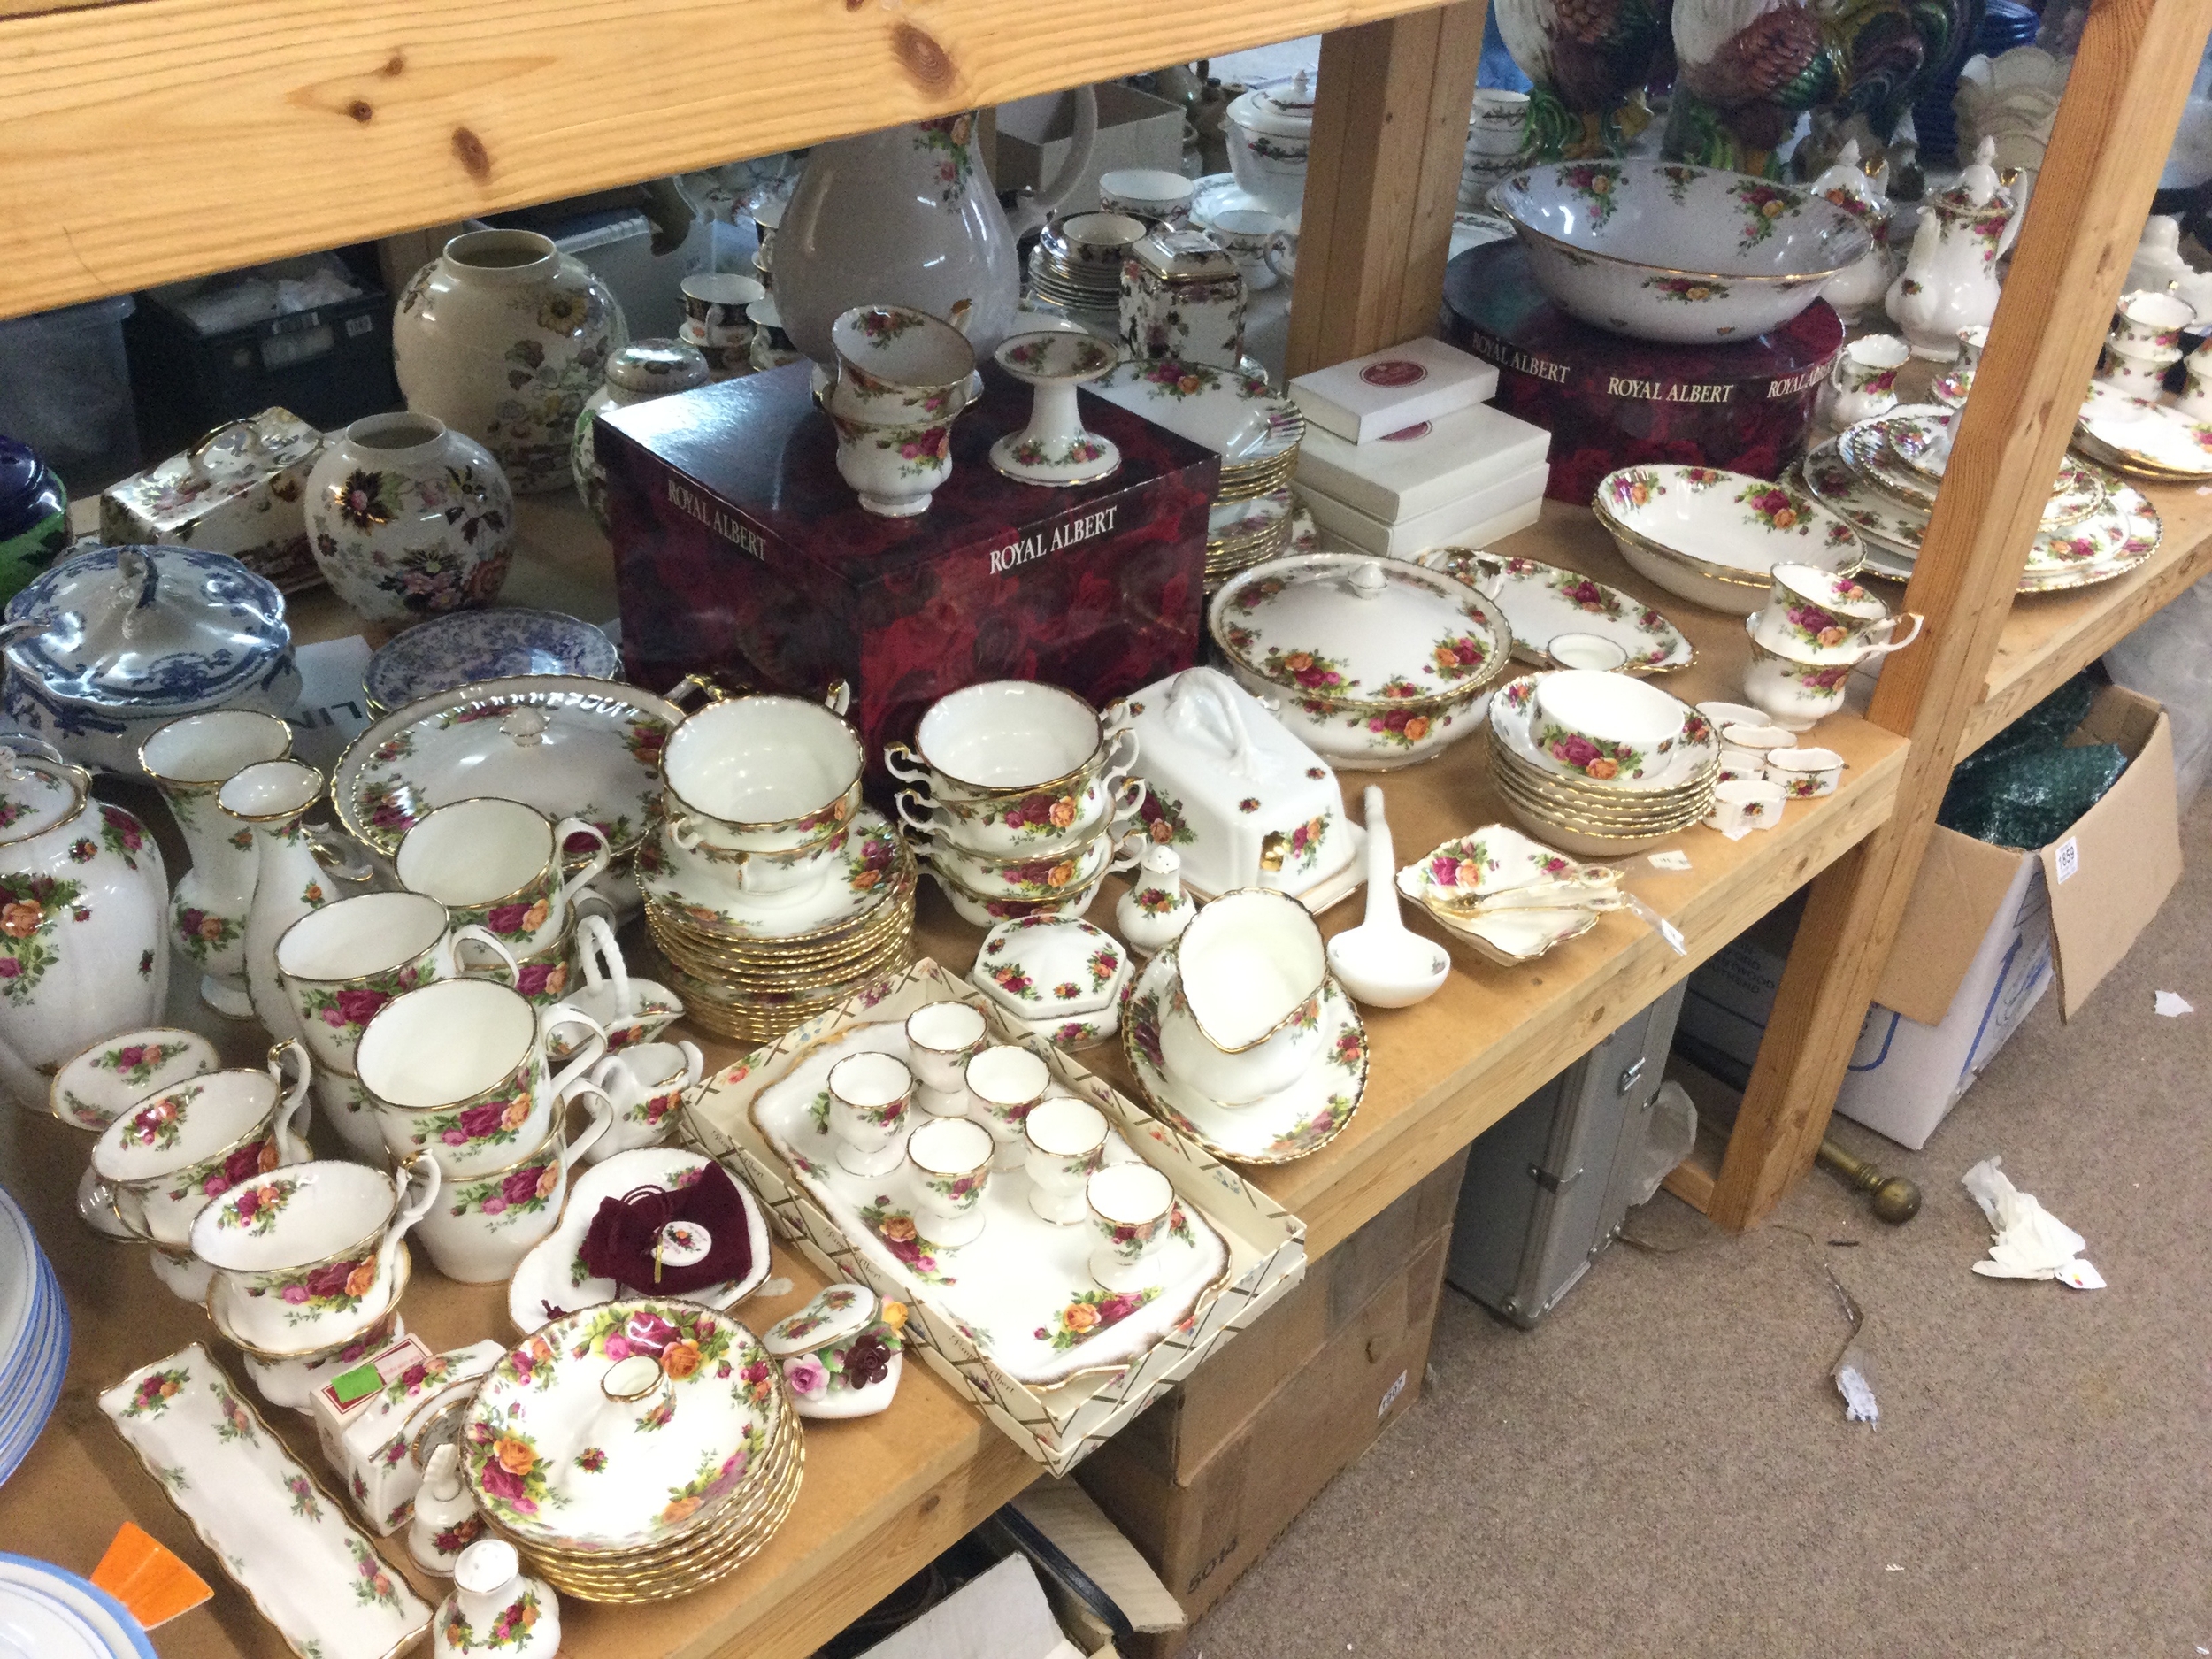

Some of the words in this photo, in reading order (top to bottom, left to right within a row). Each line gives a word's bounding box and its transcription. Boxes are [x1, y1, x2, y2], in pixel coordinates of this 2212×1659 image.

[1472, 331, 1508, 365] ROYAL
[1510, 352, 1571, 384] ALBERT
[1608, 377, 1663, 400] ROYAL
[1666, 384, 1734, 403] ALBERT
[1767, 373, 1808, 398] ROYAL
[668, 479, 710, 526] ROYAL
[713, 510, 766, 562] ALBERT
[989, 534, 1047, 575] ROYAL
[1050, 505, 1118, 552] ALBERT
[2058, 846, 2075, 870] 1859
